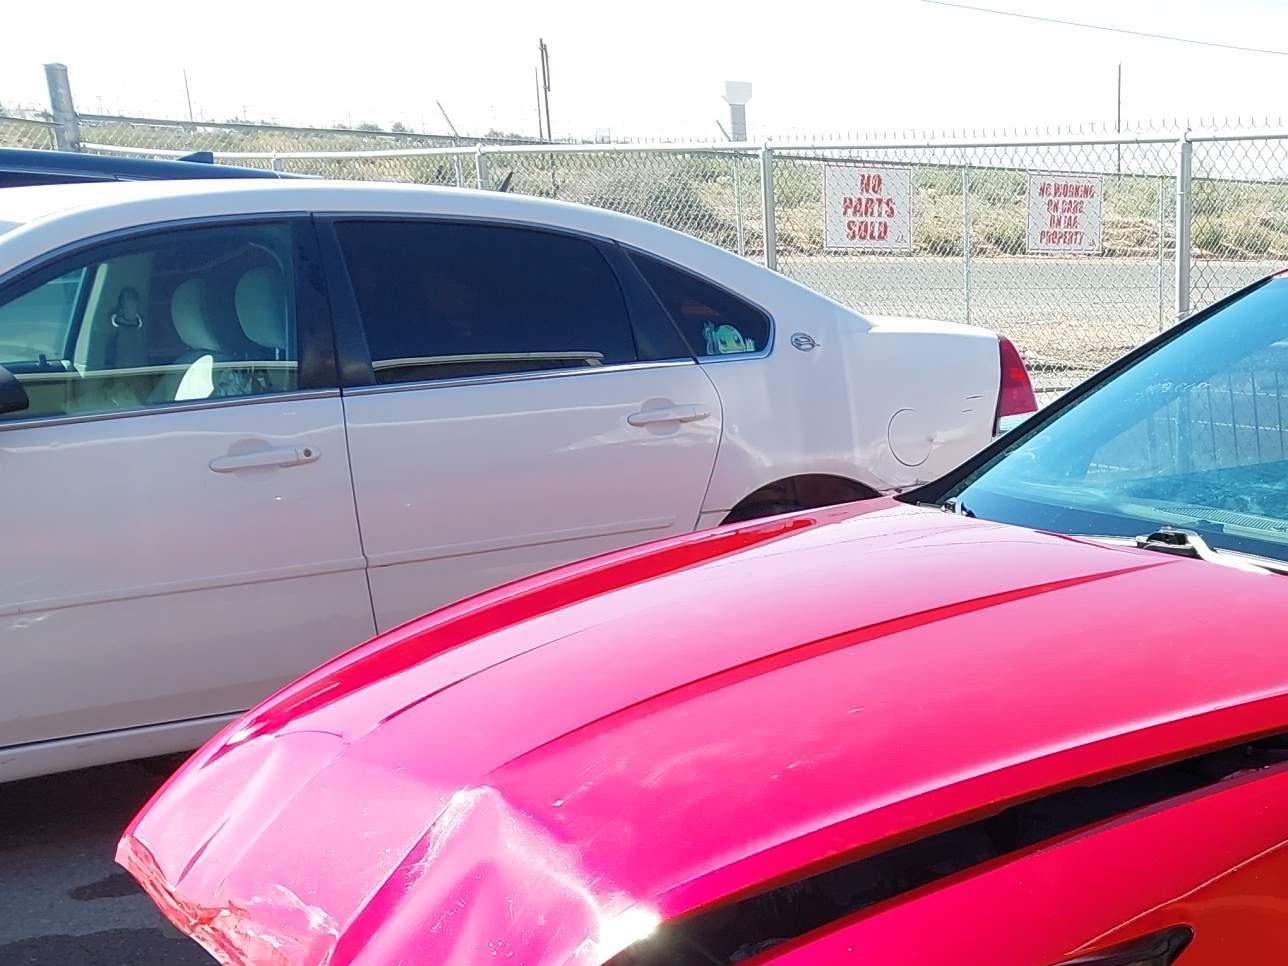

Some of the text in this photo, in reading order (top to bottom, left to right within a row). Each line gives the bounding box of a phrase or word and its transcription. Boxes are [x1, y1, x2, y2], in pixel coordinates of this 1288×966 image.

[860, 173, 883, 194] NO
[842, 196, 896, 218] PARTS
[846, 220, 888, 240] SOLD
[1040, 230, 1085, 245] PROPERTY
